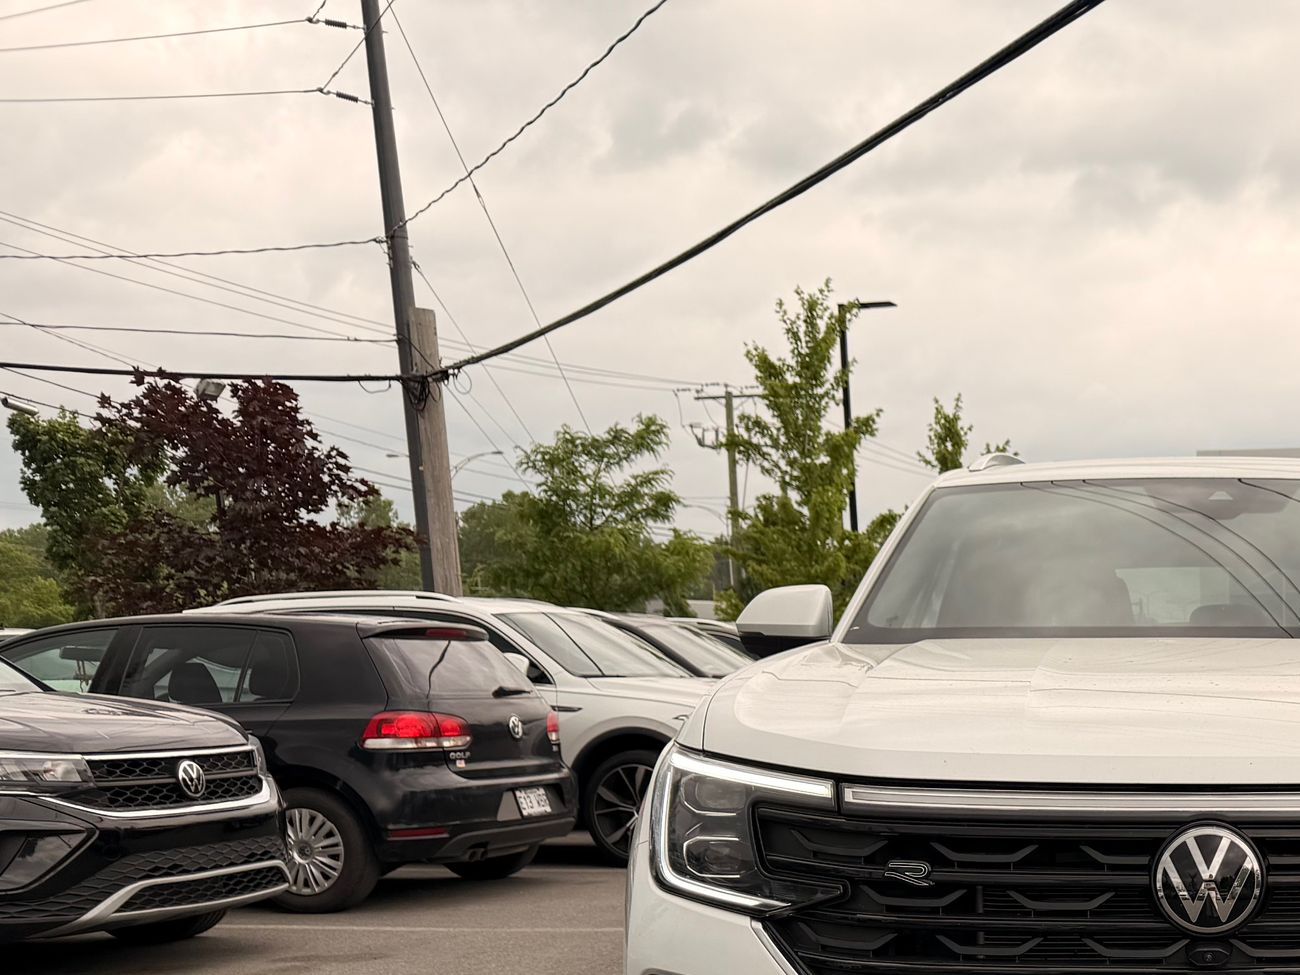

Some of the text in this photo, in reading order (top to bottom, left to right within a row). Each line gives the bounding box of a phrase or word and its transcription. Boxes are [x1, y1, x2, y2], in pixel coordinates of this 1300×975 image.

[449, 751, 472, 760] GOLF
[179, 760, 206, 797] VW
[1158, 830, 1260, 930] VW
